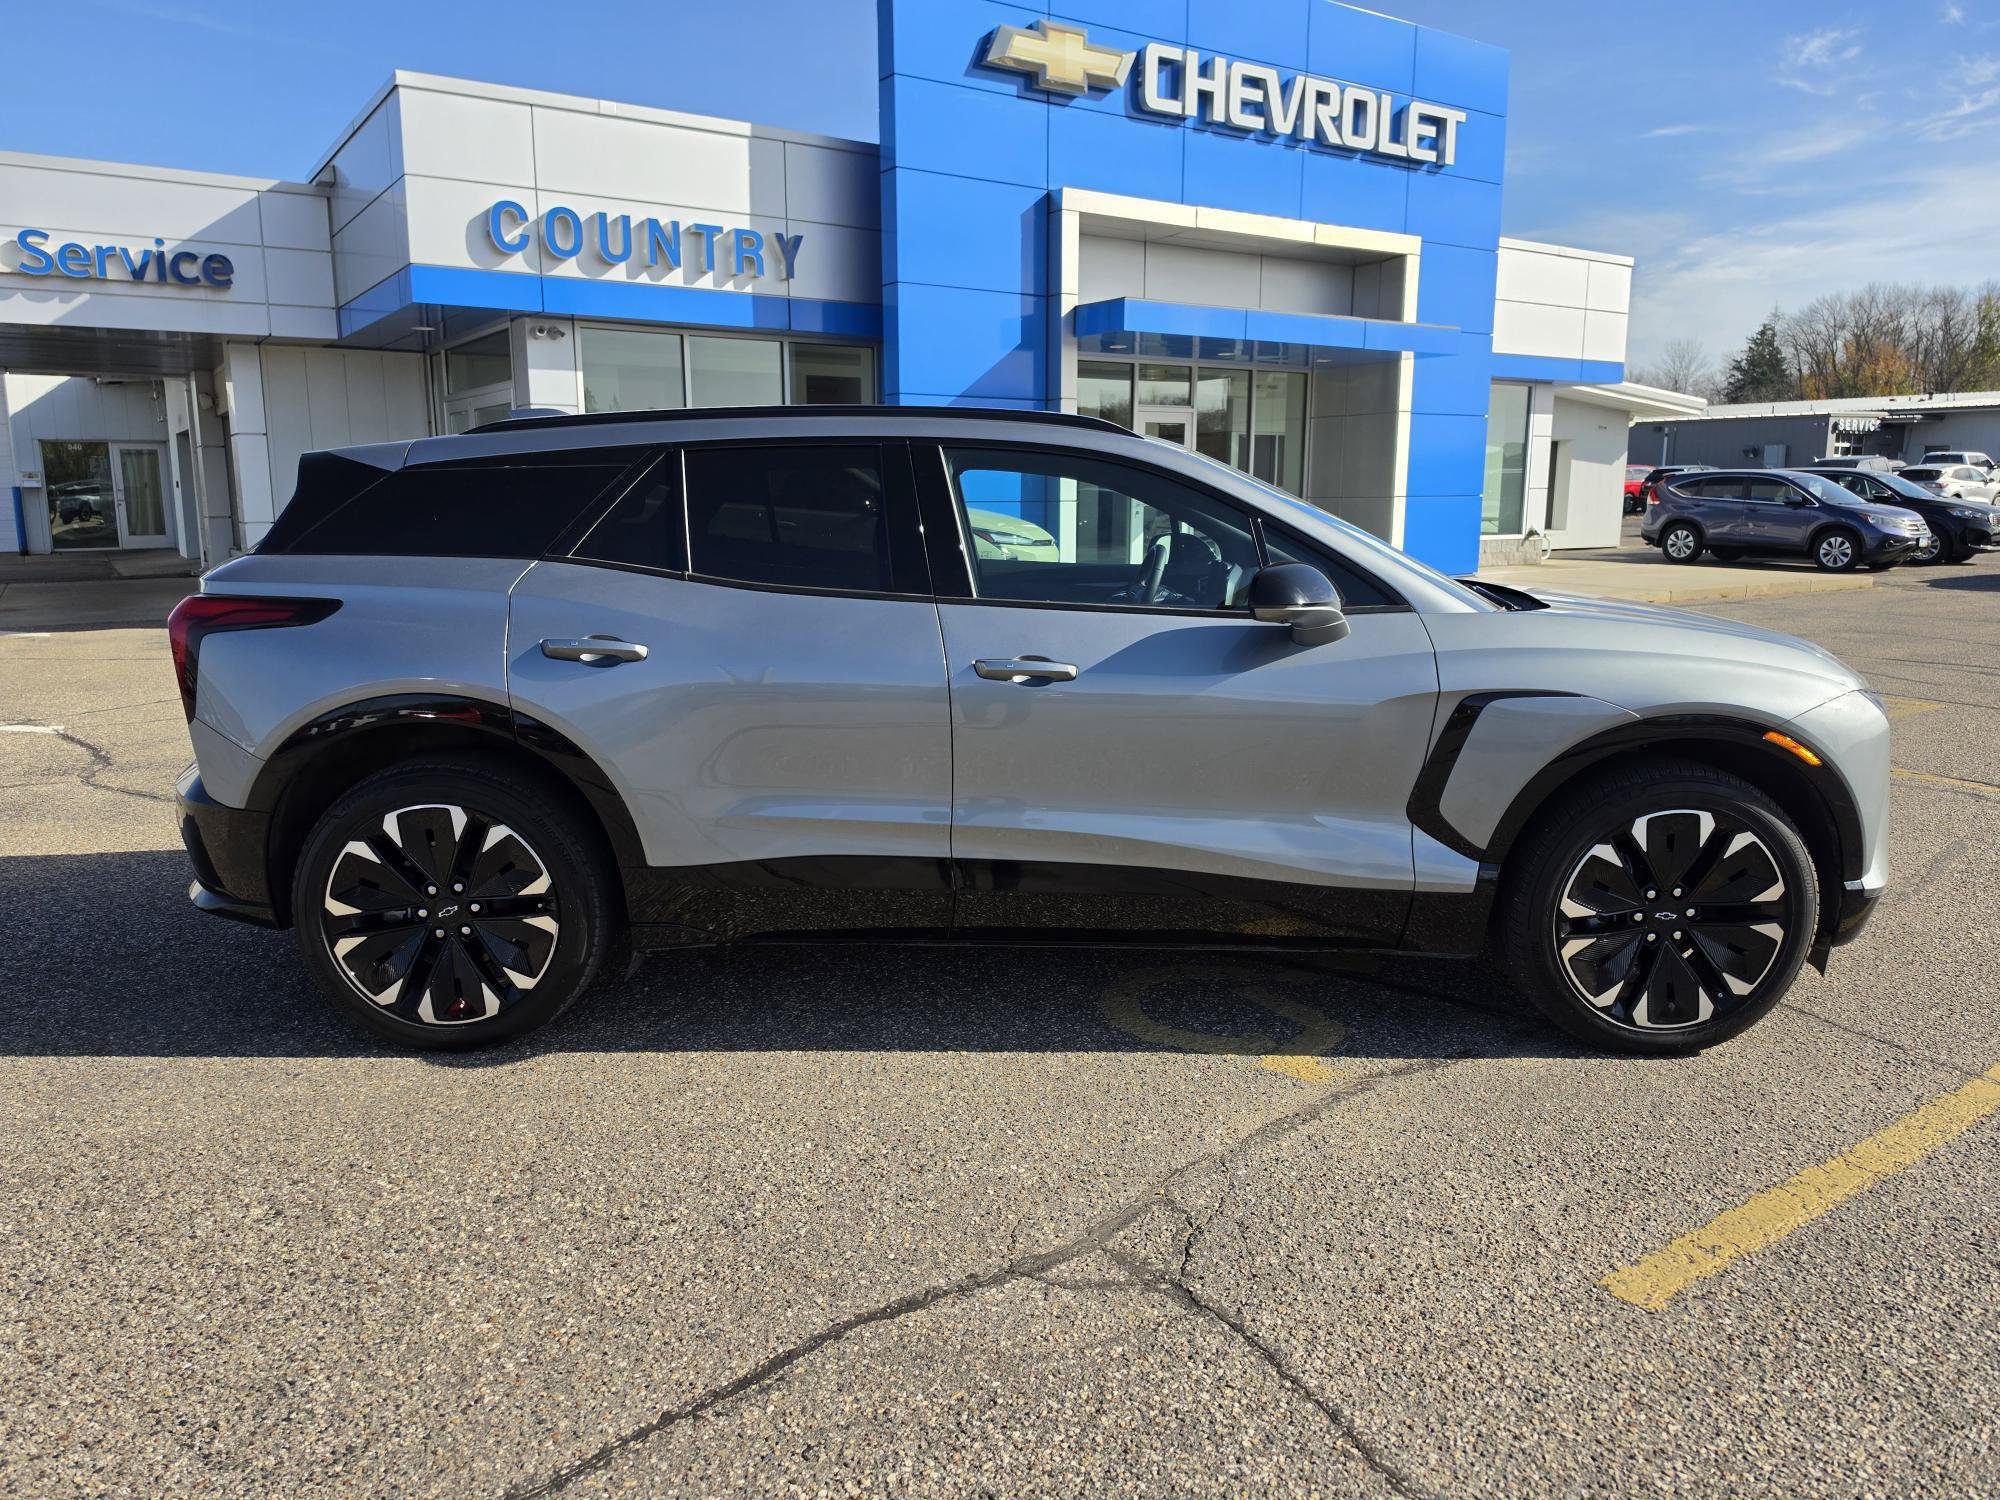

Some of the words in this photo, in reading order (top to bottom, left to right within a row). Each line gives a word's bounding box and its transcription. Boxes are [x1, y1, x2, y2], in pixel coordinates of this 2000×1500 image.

[1143, 42, 1467, 166] CHEVROLET
[17, 228, 235, 287] Service
[489, 200, 804, 282] COUNTRY
